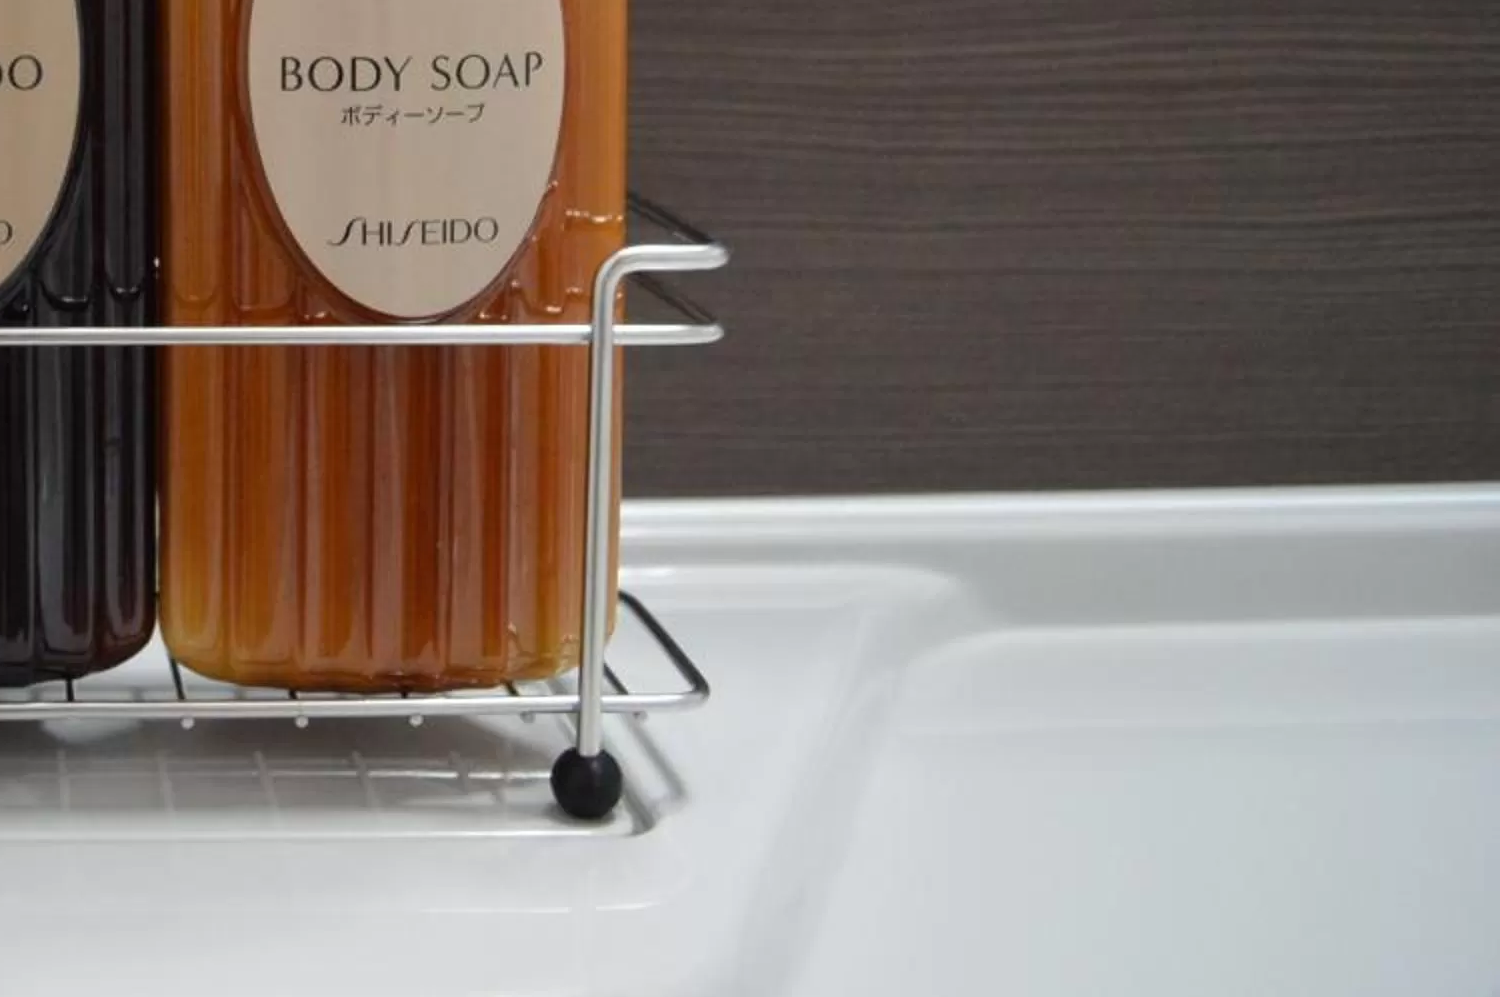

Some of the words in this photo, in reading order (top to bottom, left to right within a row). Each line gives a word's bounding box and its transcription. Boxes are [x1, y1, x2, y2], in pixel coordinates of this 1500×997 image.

[280, 55, 412, 92] BODY
[430, 50, 544, 92] SOAP
[340, 102, 486, 127] ボディーソープ
[327, 217, 499, 247] SHISEIDO
